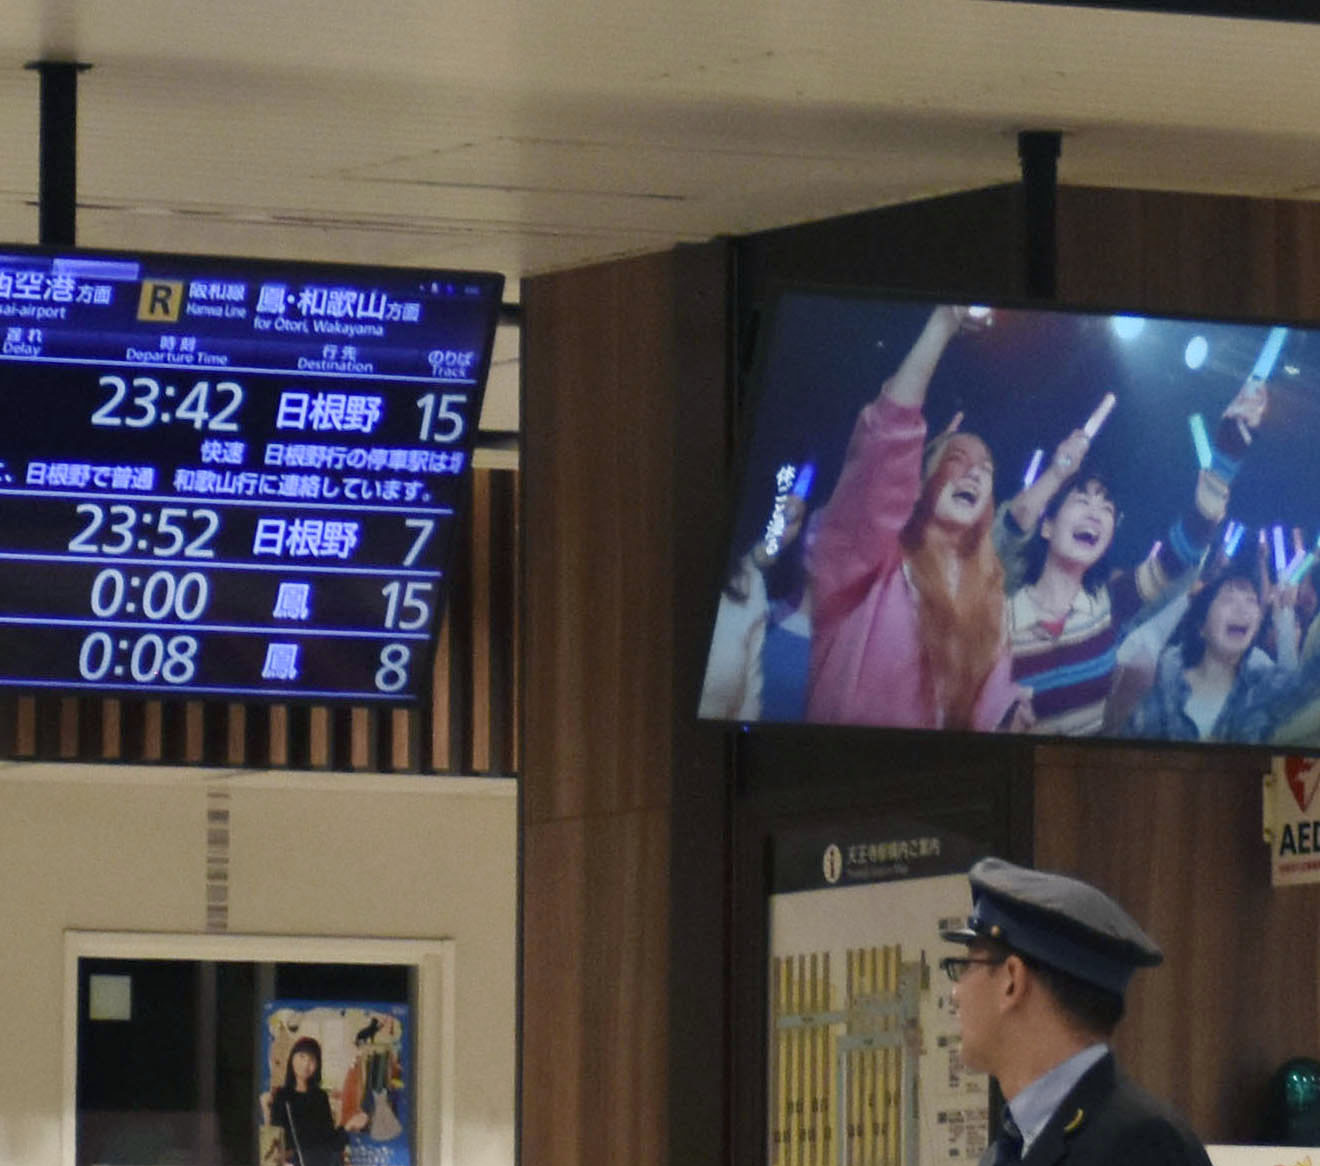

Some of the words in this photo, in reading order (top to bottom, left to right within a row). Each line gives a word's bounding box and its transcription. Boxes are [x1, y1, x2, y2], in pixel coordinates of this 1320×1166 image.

[149, 284, 172, 315] R
[254, 316, 270, 330] for
[313, 319, 384, 337] Wakayama
[3, 341, 42, 357] Delay
[126, 348, 195, 364] Departure
[198, 352, 228, 366] Time
[427, 350, 474, 368] のりば
[297, 357, 374, 374] Destination
[431, 364, 467, 378] Track
[91, 376, 244, 431] 23:42
[275, 391, 383, 434] 日根野
[416, 394, 467, 442] 15
[201, 440, 245, 465] 快速
[68, 503, 221, 559] 23:52
[252, 518, 359, 559] 日根野
[402, 519, 434, 566] 7
[91, 568, 208, 620] 0:00
[273, 582, 314, 620] 鳳
[381, 581, 432, 629] 15
[79, 632, 197, 684] 0:08
[261, 643, 303, 680] 鳳
[374, 644, 410, 692] 8
